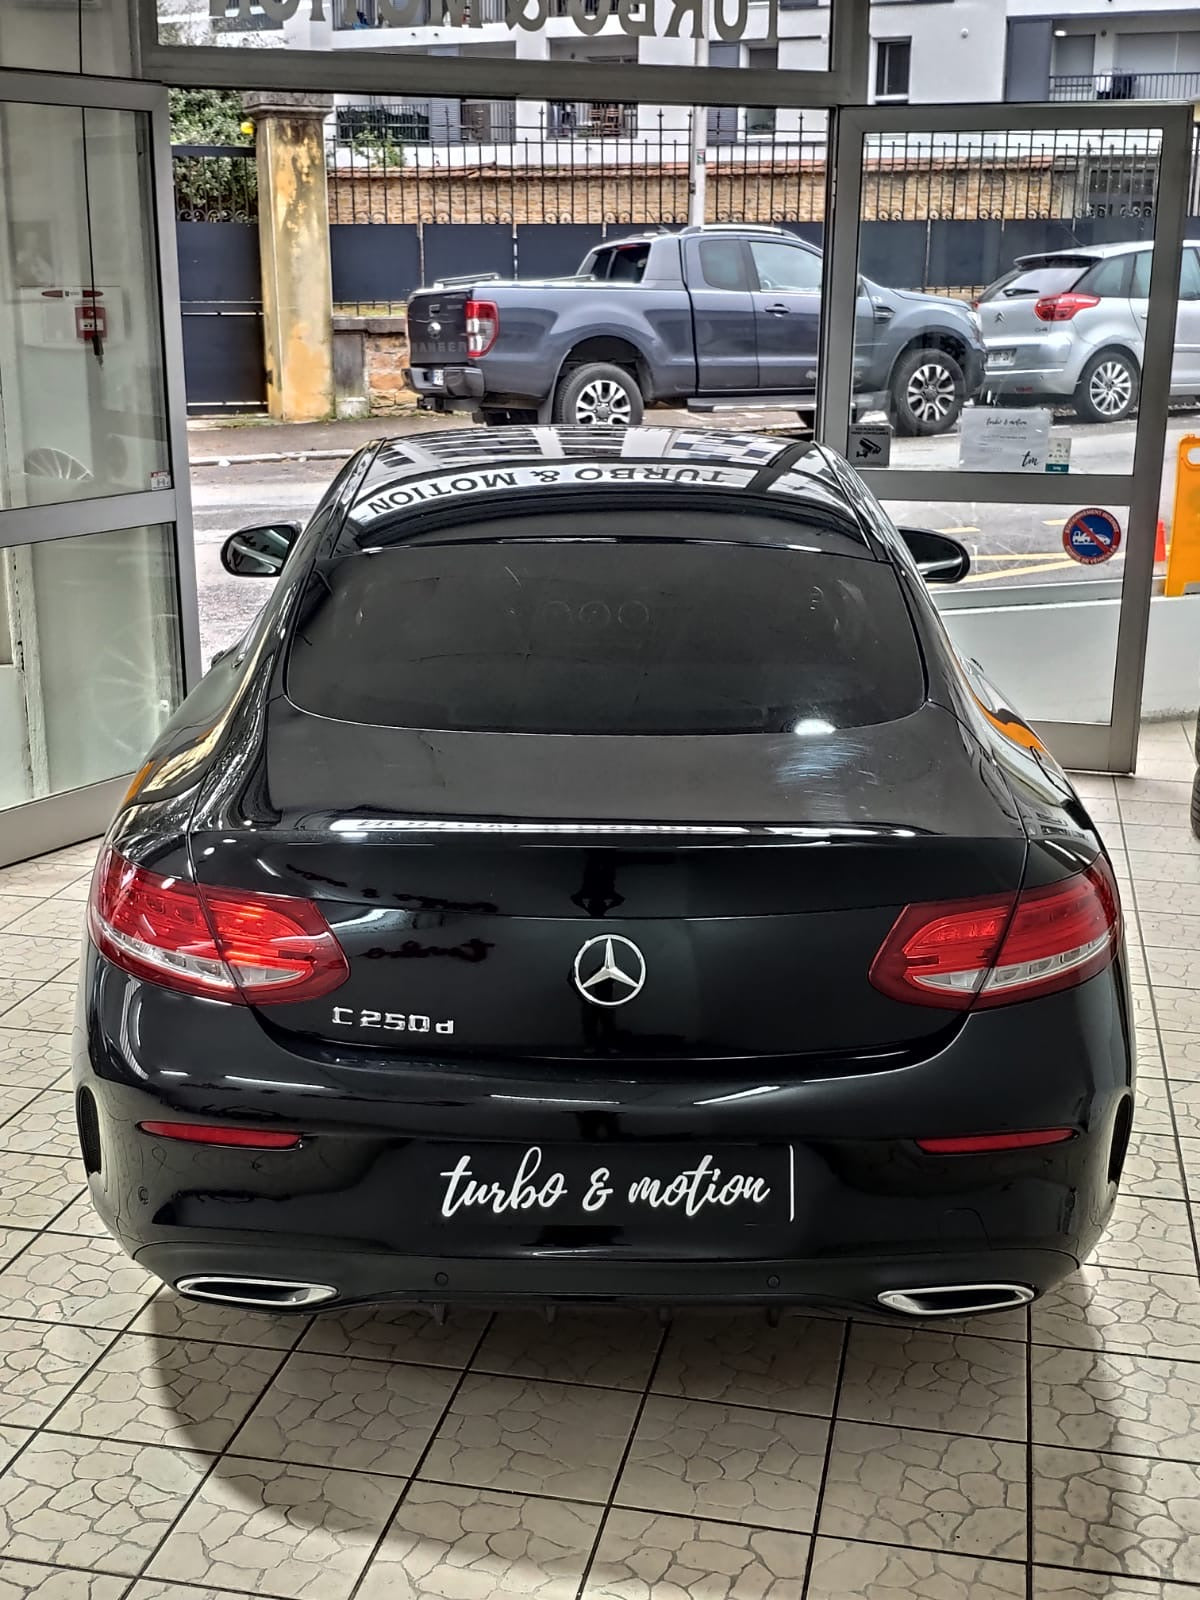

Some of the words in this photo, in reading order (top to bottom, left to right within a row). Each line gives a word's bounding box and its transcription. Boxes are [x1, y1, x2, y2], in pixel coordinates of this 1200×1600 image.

[531, 470, 561, 483] &
[574, 465, 734, 483] TURBO
[368, 471, 519, 515] MOTION
[331, 1006, 354, 1025] C
[440, 1146, 568, 1217] turbo
[582, 1167, 614, 1212] &
[628, 1154, 771, 1217] motion
